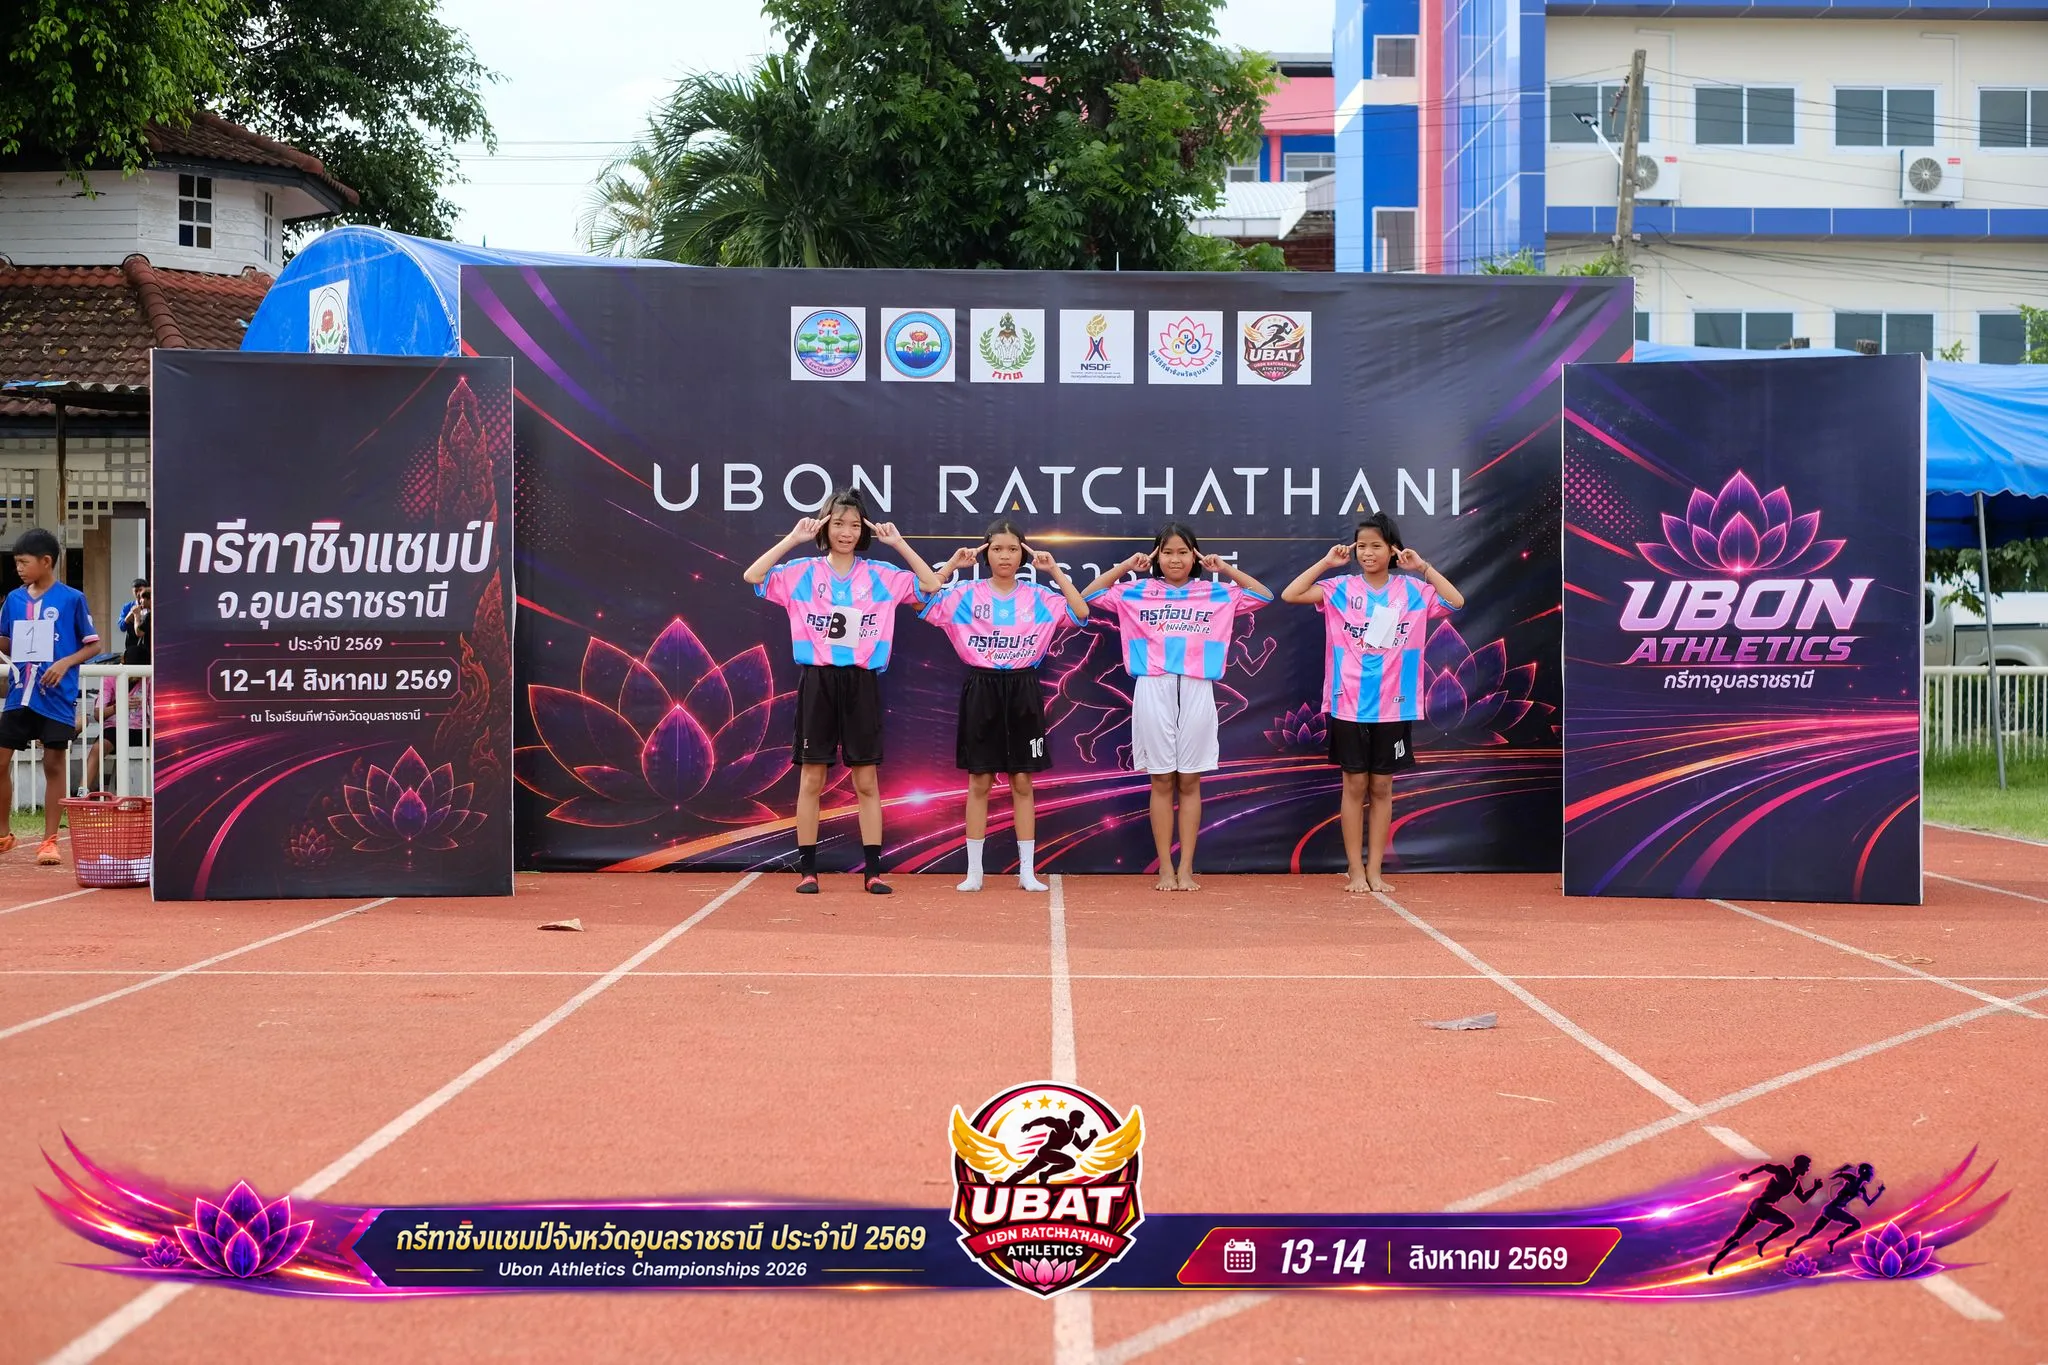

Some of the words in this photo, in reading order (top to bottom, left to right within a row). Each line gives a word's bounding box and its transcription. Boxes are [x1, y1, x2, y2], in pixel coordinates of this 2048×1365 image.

[1249, 348, 1300, 362] UBAT
[992, 370, 1023, 380] กกท
[1080, 363, 1111, 371] NSDF
[653, 463, 892, 513] UBON
[938, 465, 1461, 516] RATCHATHANI
[216, 580, 449, 630] จ.อุบลราชธานี
[1140, 603, 1193, 626] ครูท็อป
[1195, 610, 1213, 622] FC
[1619, 578, 1876, 632] UBON
[860, 613, 877, 627] FC
[26, 626, 37, 655] 1
[288, 635, 341, 652] ประจำปี
[345, 637, 383, 652] 2569
[967, 630, 1021, 653] ครูท็อป
[1622, 636, 1863, 665] ATHLETICS
[303, 668, 388, 692] สิงหาคม
[395, 669, 452, 691] 2569
[1663, 669, 1816, 695] กรีฑาอุบลราชธานี
[250, 713, 262, 723] ณ
[1029, 737, 1044, 758] 10
